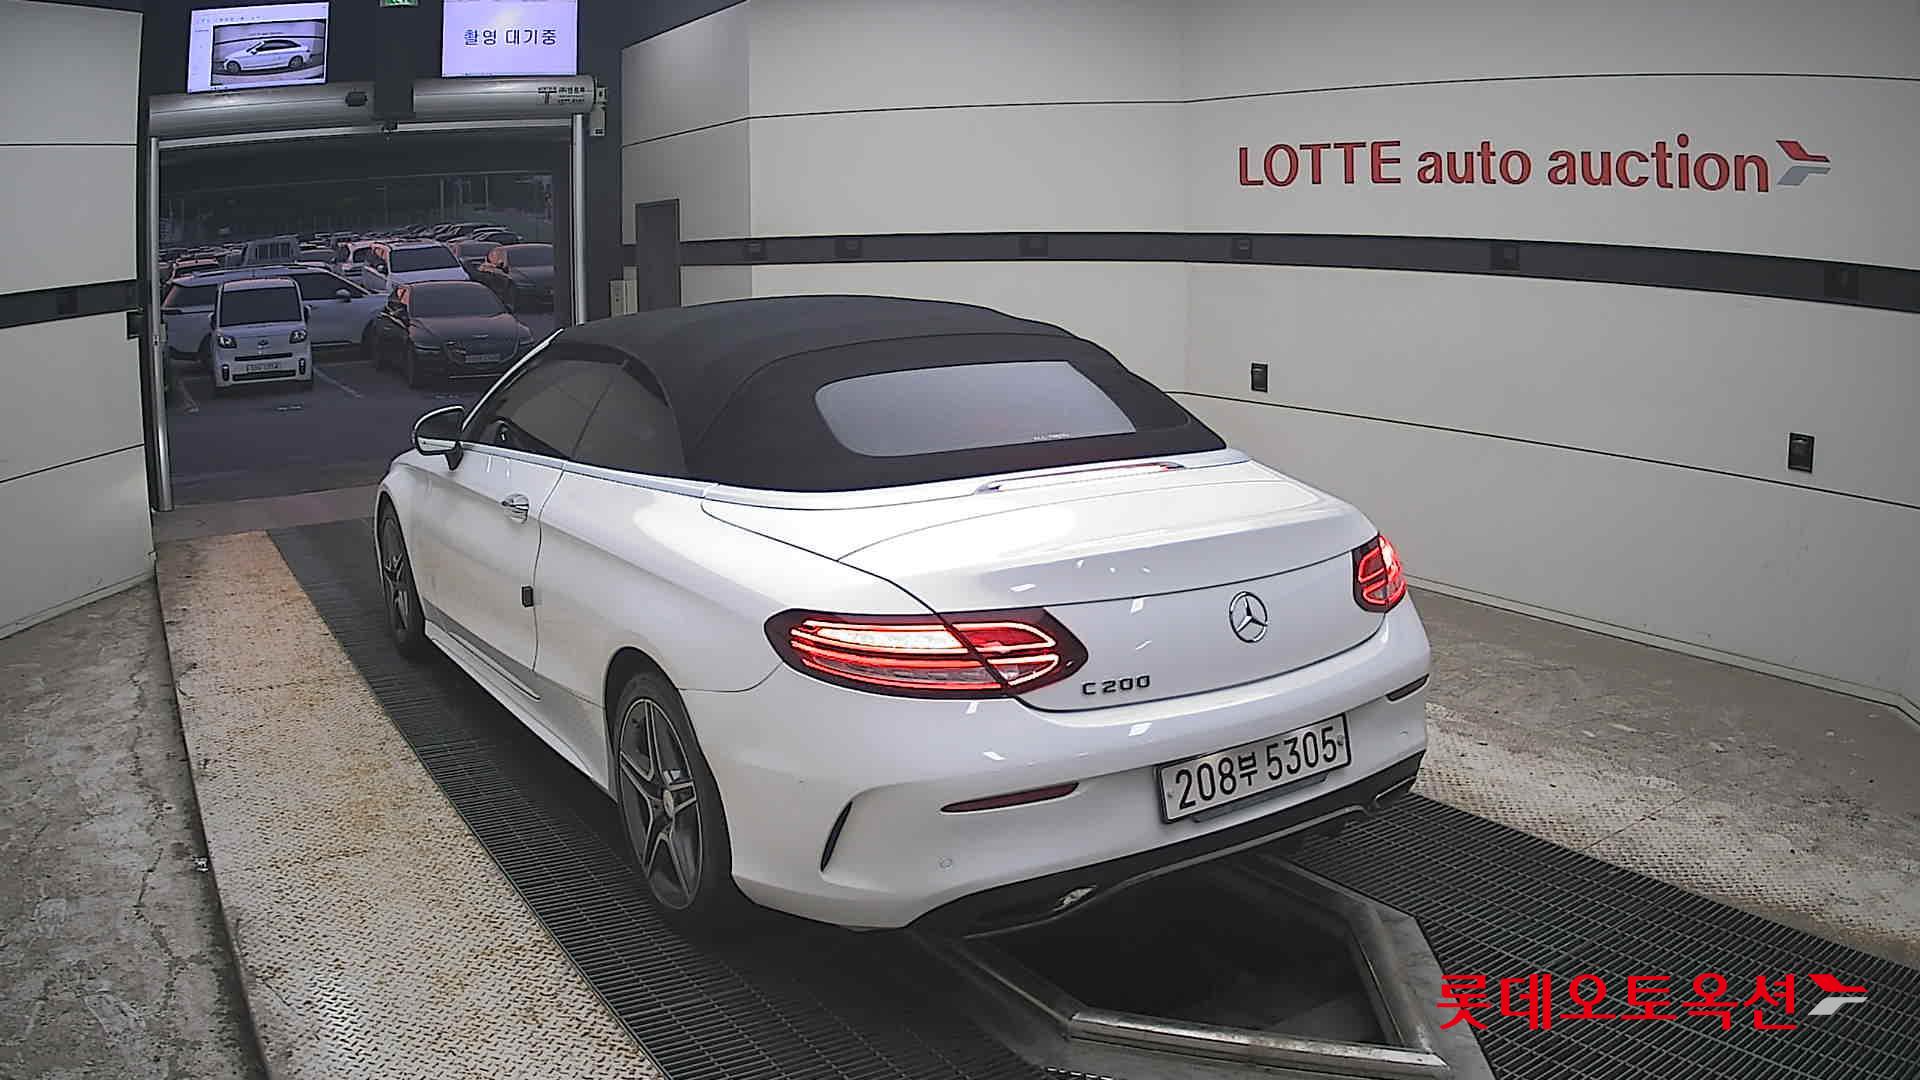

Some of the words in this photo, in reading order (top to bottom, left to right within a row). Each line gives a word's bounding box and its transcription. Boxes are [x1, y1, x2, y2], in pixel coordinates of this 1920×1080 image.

[464, 29, 497, 46] 촬영
[505, 29, 557, 46] 대기중
[1238, 140, 1401, 187] LOTTE
[1416, 140, 1532, 186] auto
[1547, 133, 1770, 193] auction
[1081, 681, 1096, 697] C
[1102, 674, 1151, 694] 200
[1174, 750, 1259, 812] 208부
[1265, 725, 1338, 782] 5305
